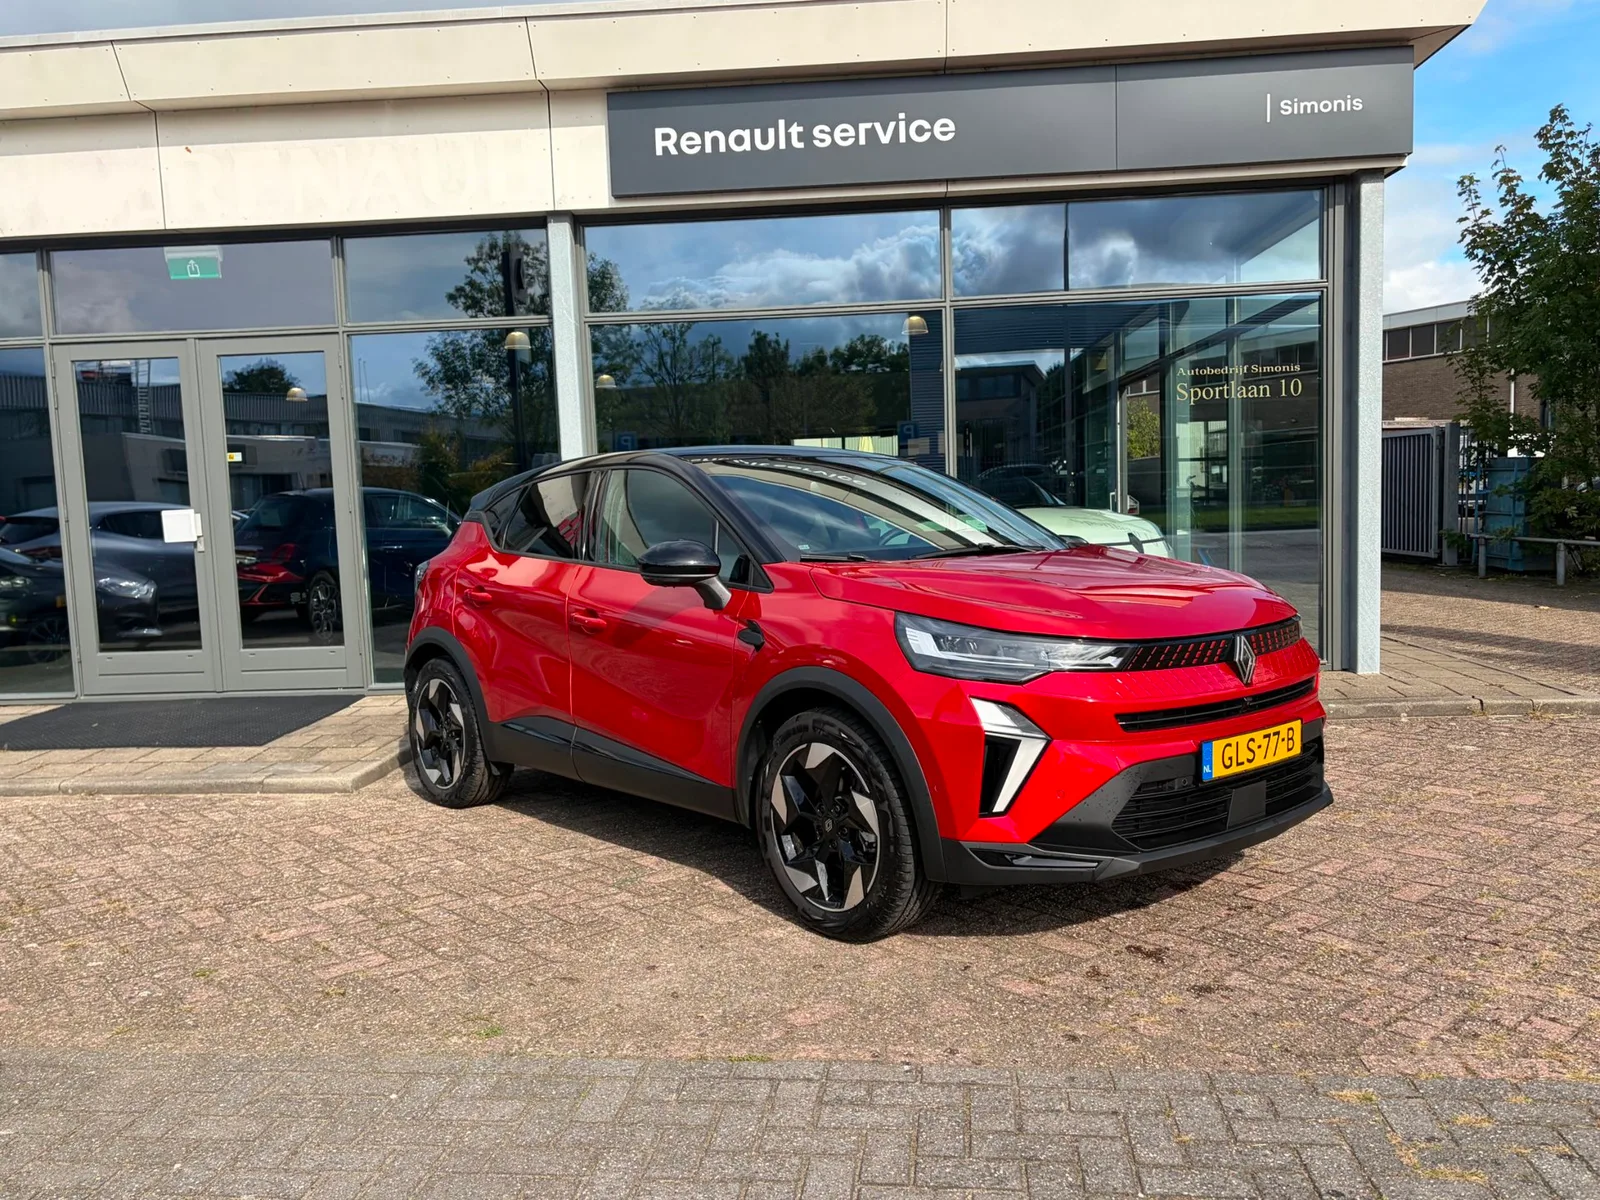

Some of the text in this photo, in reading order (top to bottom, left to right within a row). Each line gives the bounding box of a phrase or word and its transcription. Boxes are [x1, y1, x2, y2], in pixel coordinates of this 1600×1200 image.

[1279, 94, 1363, 115] Simonis
[654, 112, 957, 156] Renault service
[1176, 363, 1301, 376] Autobedrijf Simonis
[1176, 378, 1302, 405] Sportlaan 10
[1221, 726, 1295, 770] GLS-77-B
[1203, 764, 1212, 773] NL
